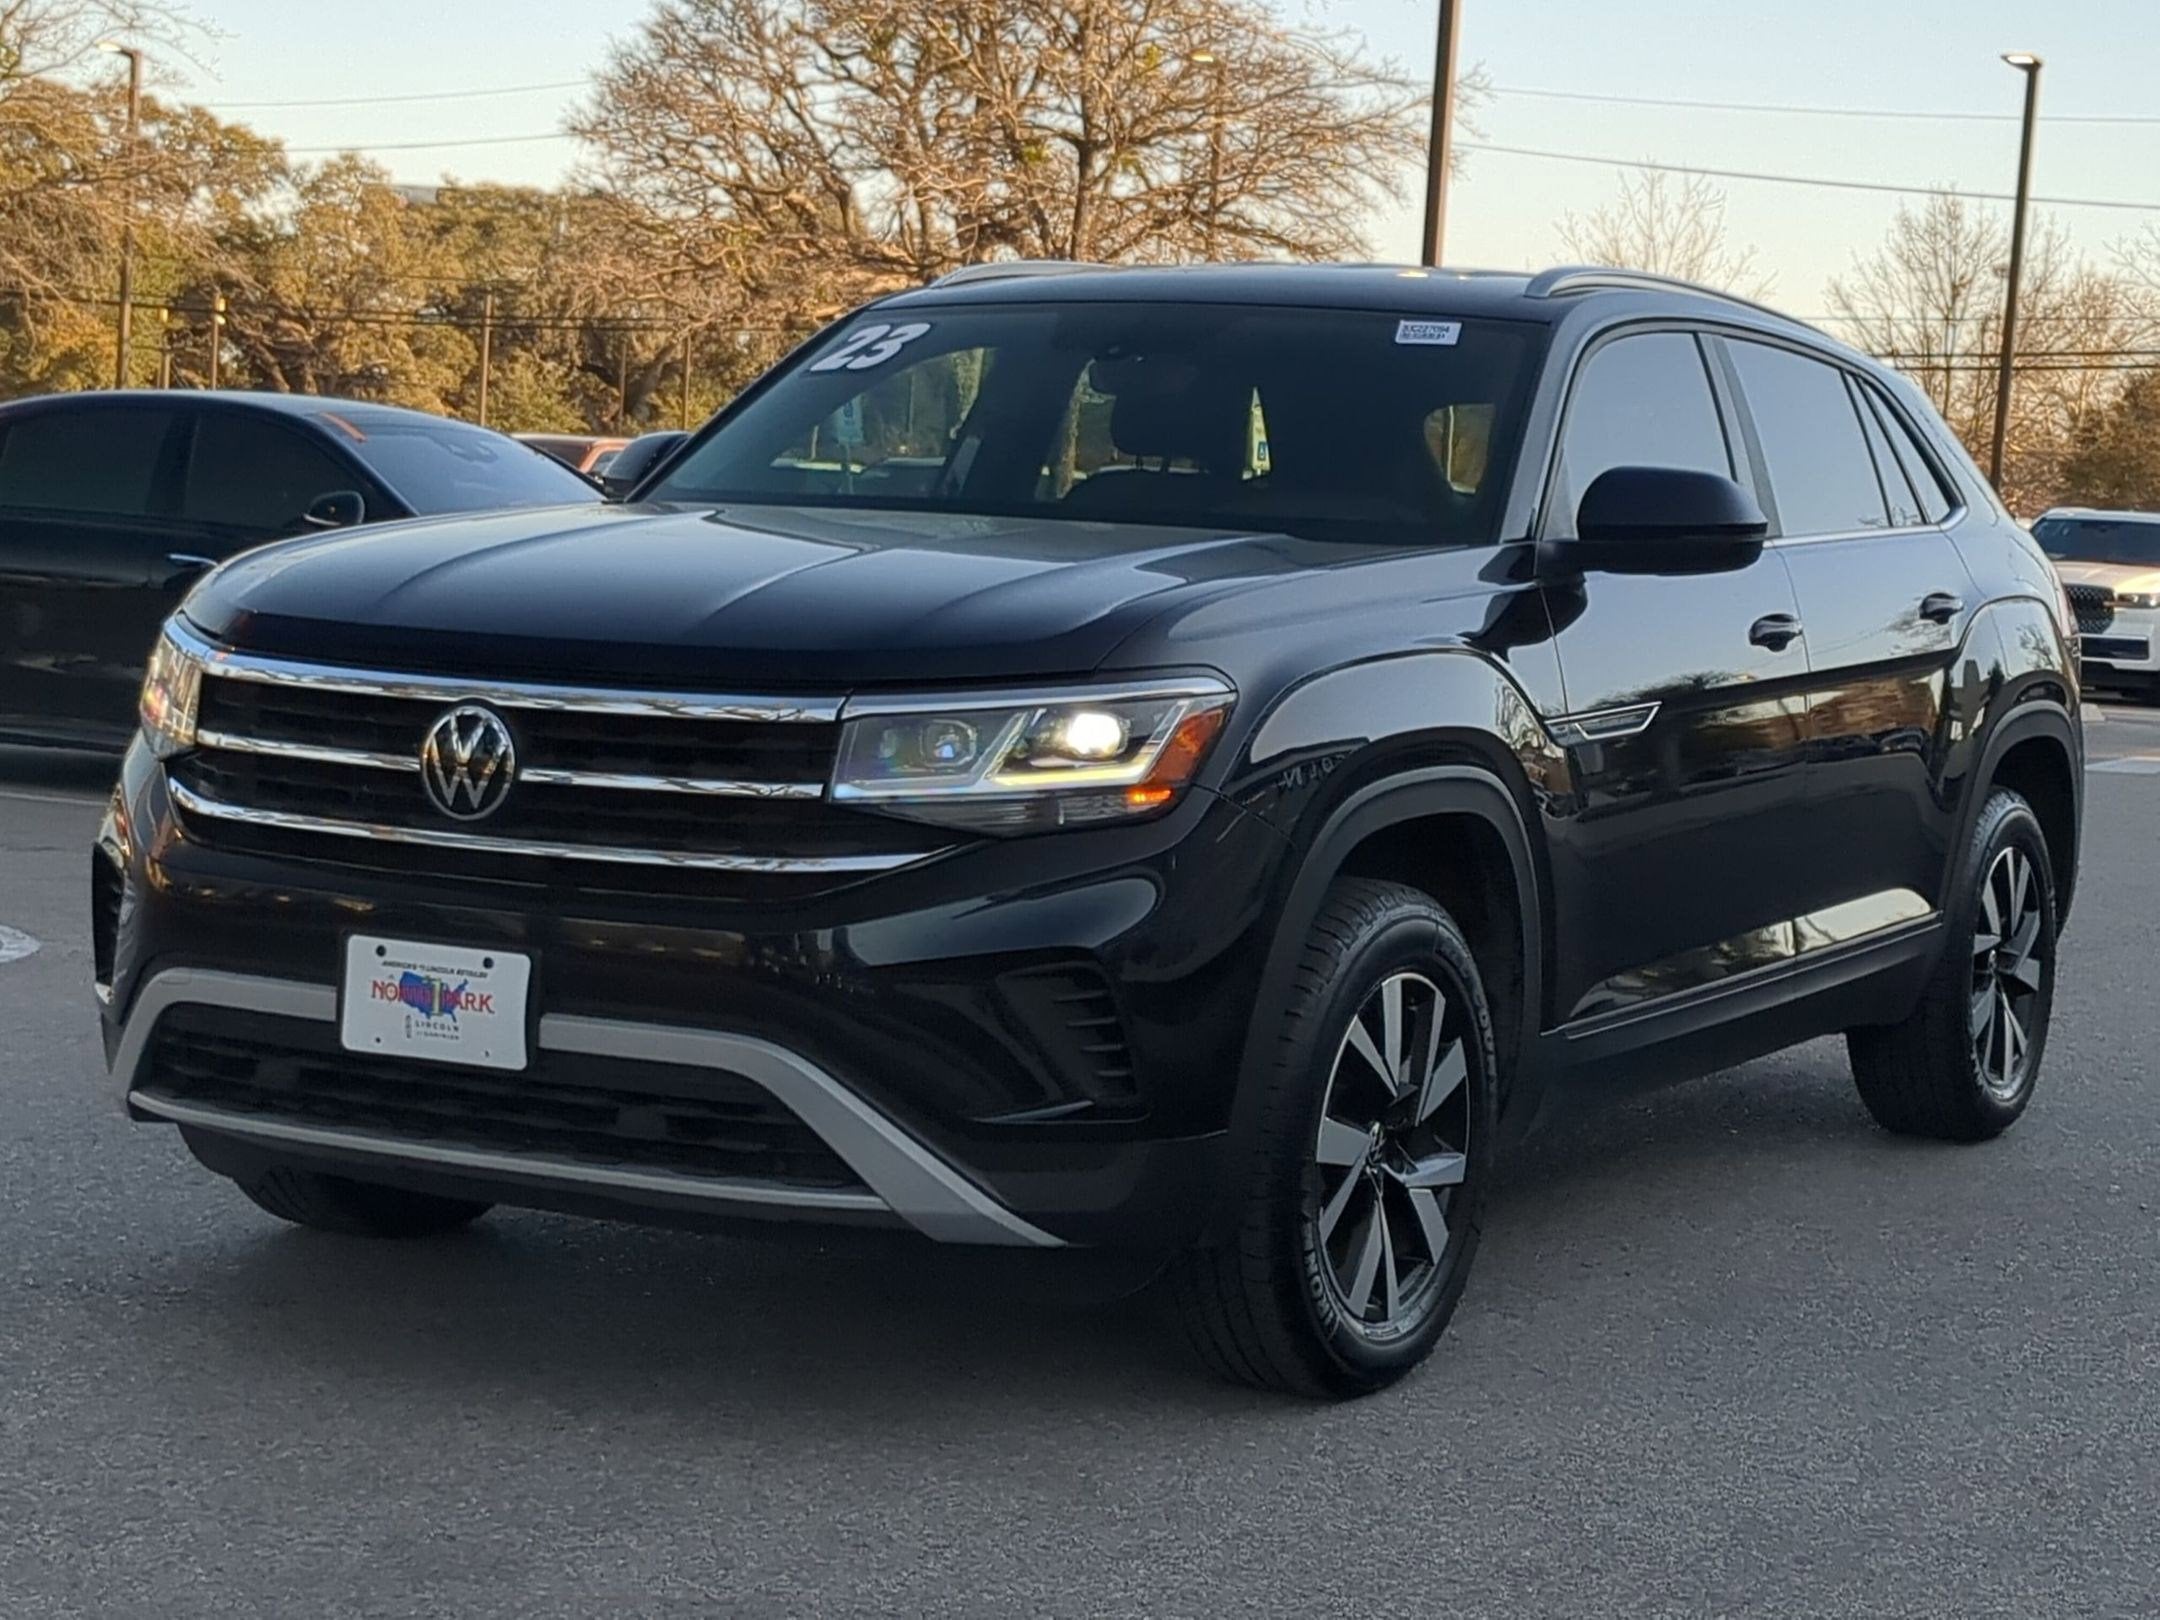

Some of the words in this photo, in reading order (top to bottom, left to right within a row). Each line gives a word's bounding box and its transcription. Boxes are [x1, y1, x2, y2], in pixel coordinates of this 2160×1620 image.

[810, 322, 931, 372] 23
[427, 709, 511, 815] VW
[415, 1019, 460, 1031] LINCOLN
